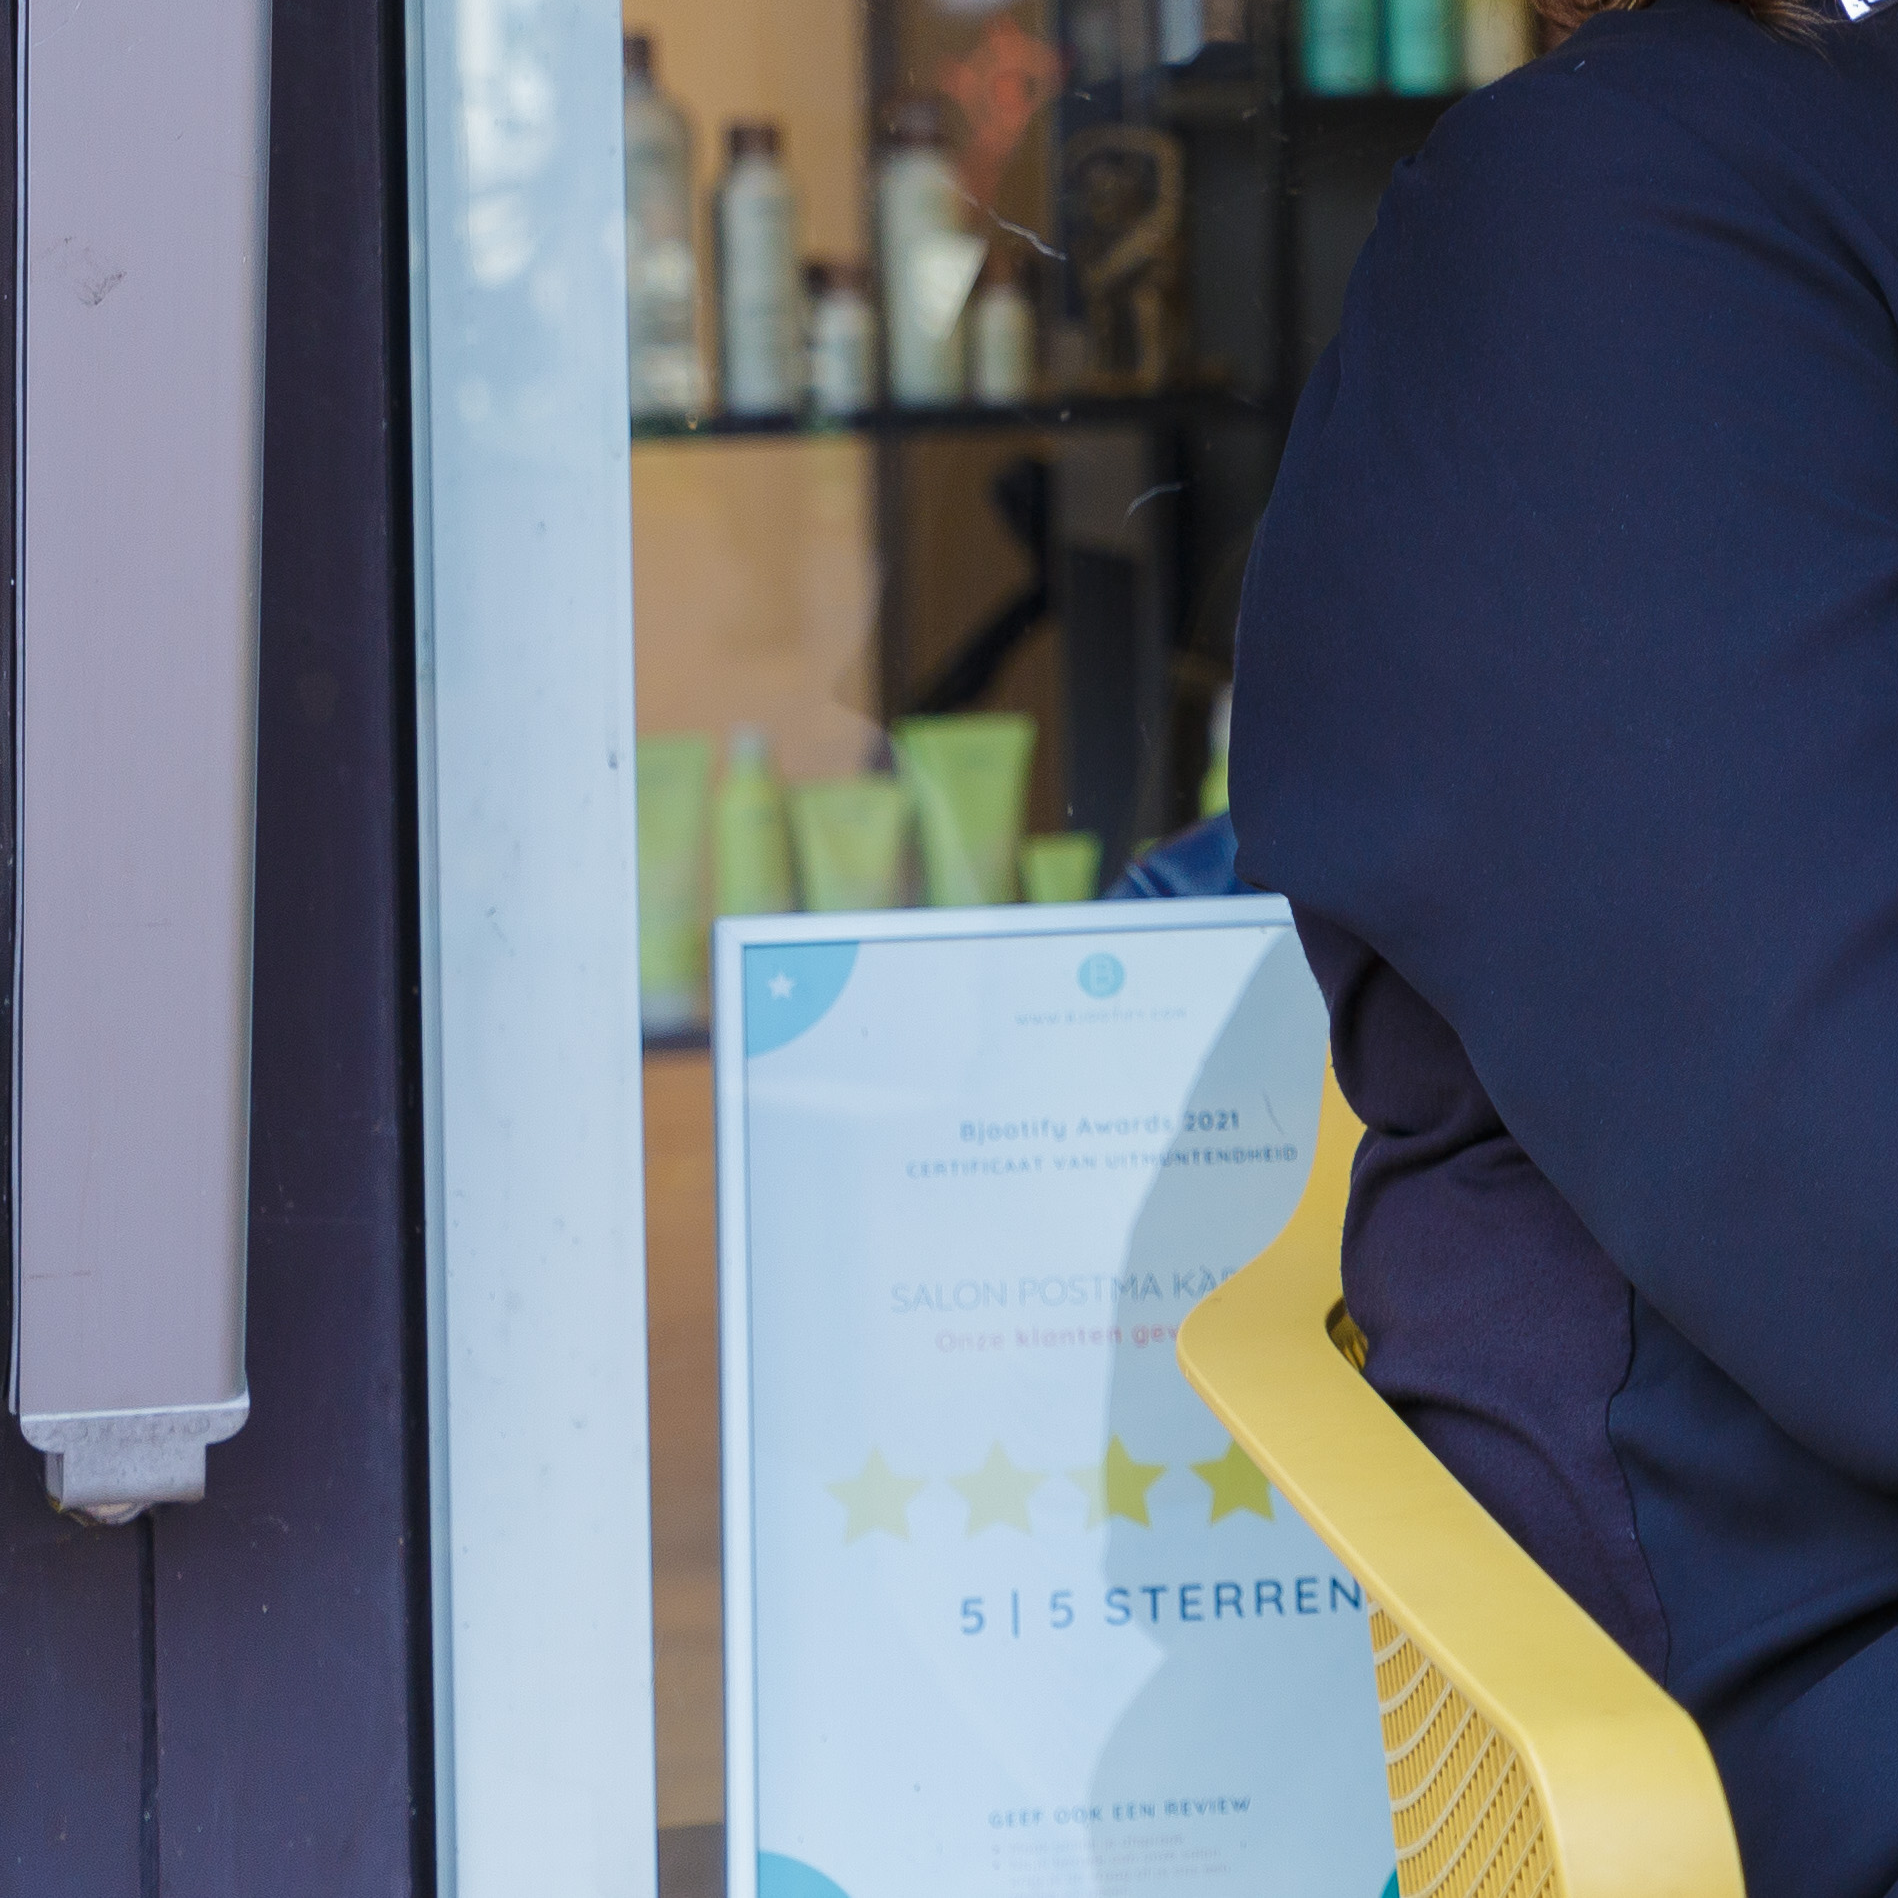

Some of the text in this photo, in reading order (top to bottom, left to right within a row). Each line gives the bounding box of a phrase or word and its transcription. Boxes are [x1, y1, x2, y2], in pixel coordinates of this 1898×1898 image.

[959, 1108, 1241, 1147] Bjootify Awards 2021
[905, 1143, 1299, 1179] CERTIFICAAT VAN UITMUNTENDHEID
[890, 1276, 1008, 1314] SALON
[1018, 1270, 1163, 1308] POSTMA
[933, 1327, 1005, 1354] Onze
[1014, 1322, 1122, 1349] klanten
[958, 1593, 988, 1637] 5
[1048, 1587, 1077, 1630] 5
[1102, 1573, 1365, 1626] STERREN
[988, 1794, 1252, 1830] GEEF OOK EEN REVIEW
